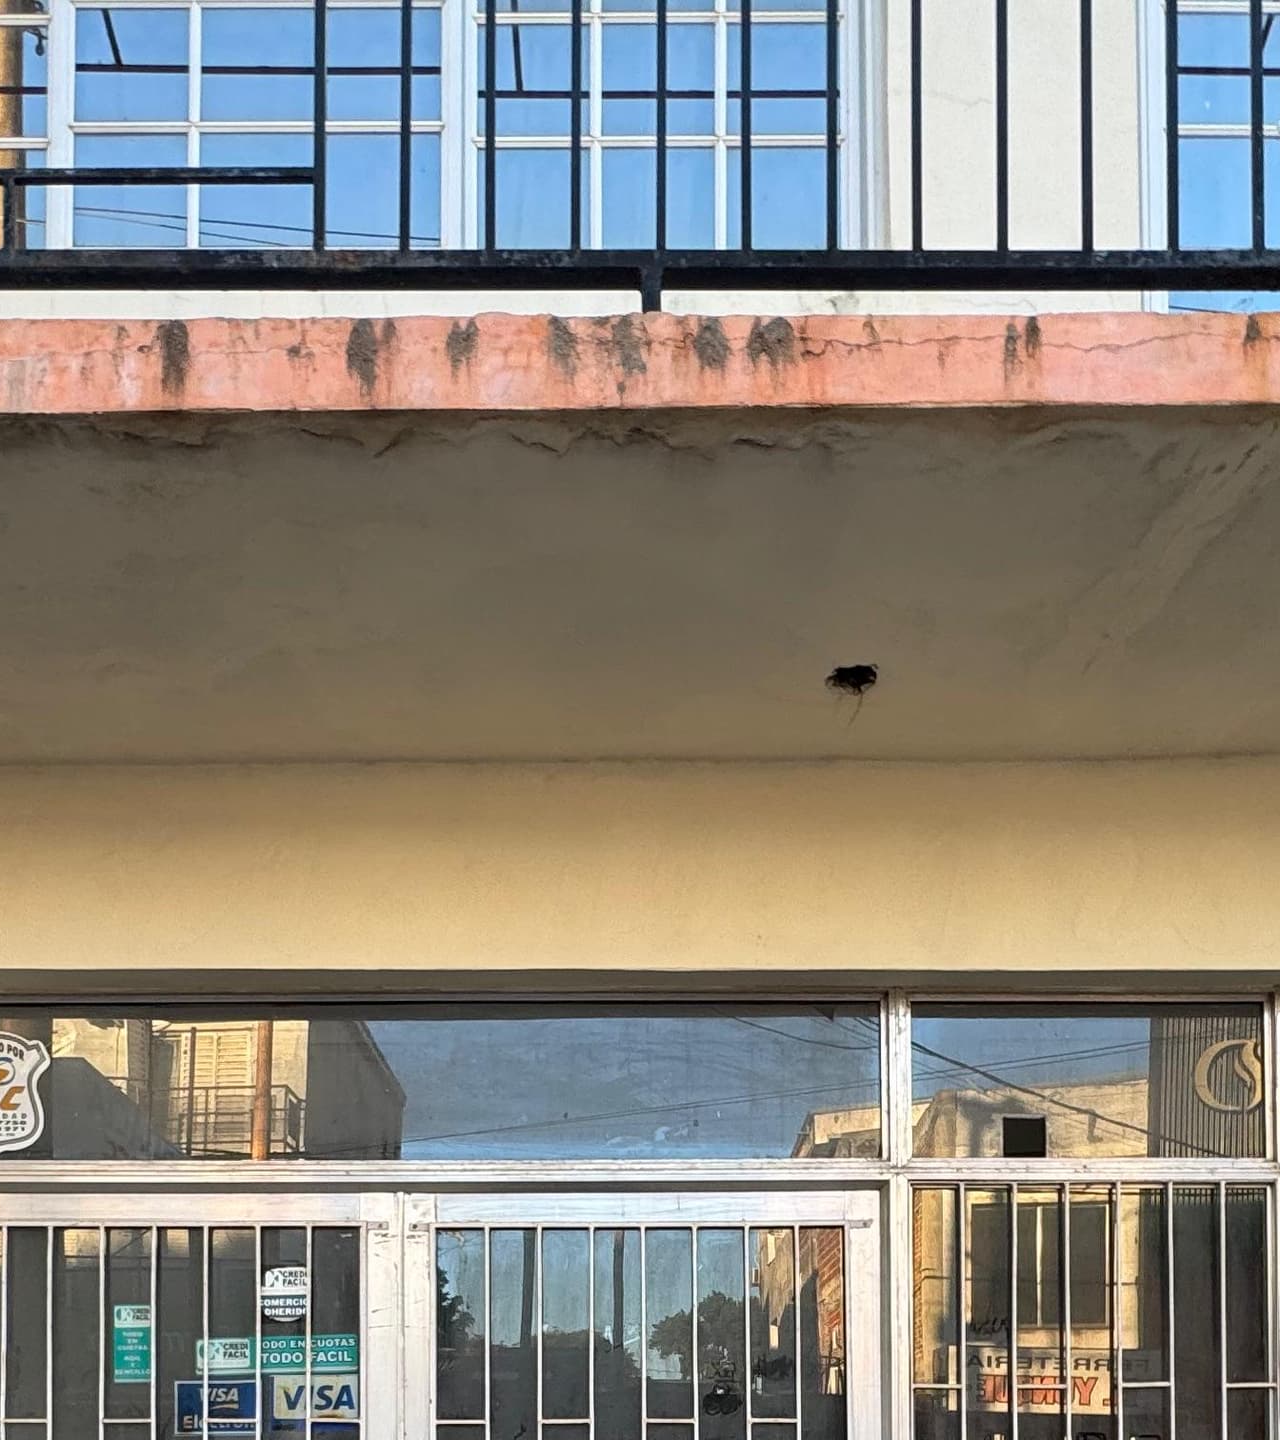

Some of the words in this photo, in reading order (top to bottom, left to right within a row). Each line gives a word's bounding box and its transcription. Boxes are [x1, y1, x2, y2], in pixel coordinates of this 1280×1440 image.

[7, 1044, 25, 1061] POR
[261, 1341, 286, 1349] ODO
[290, 1340, 305, 1348] EN
[311, 1338, 355, 1347] CUOTAS
[223, 1351, 248, 1359] FACIL
[261, 1353, 303, 1364] TODO
[311, 1351, 352, 1362] FACIL
[199, 1388, 239, 1402] VISA
